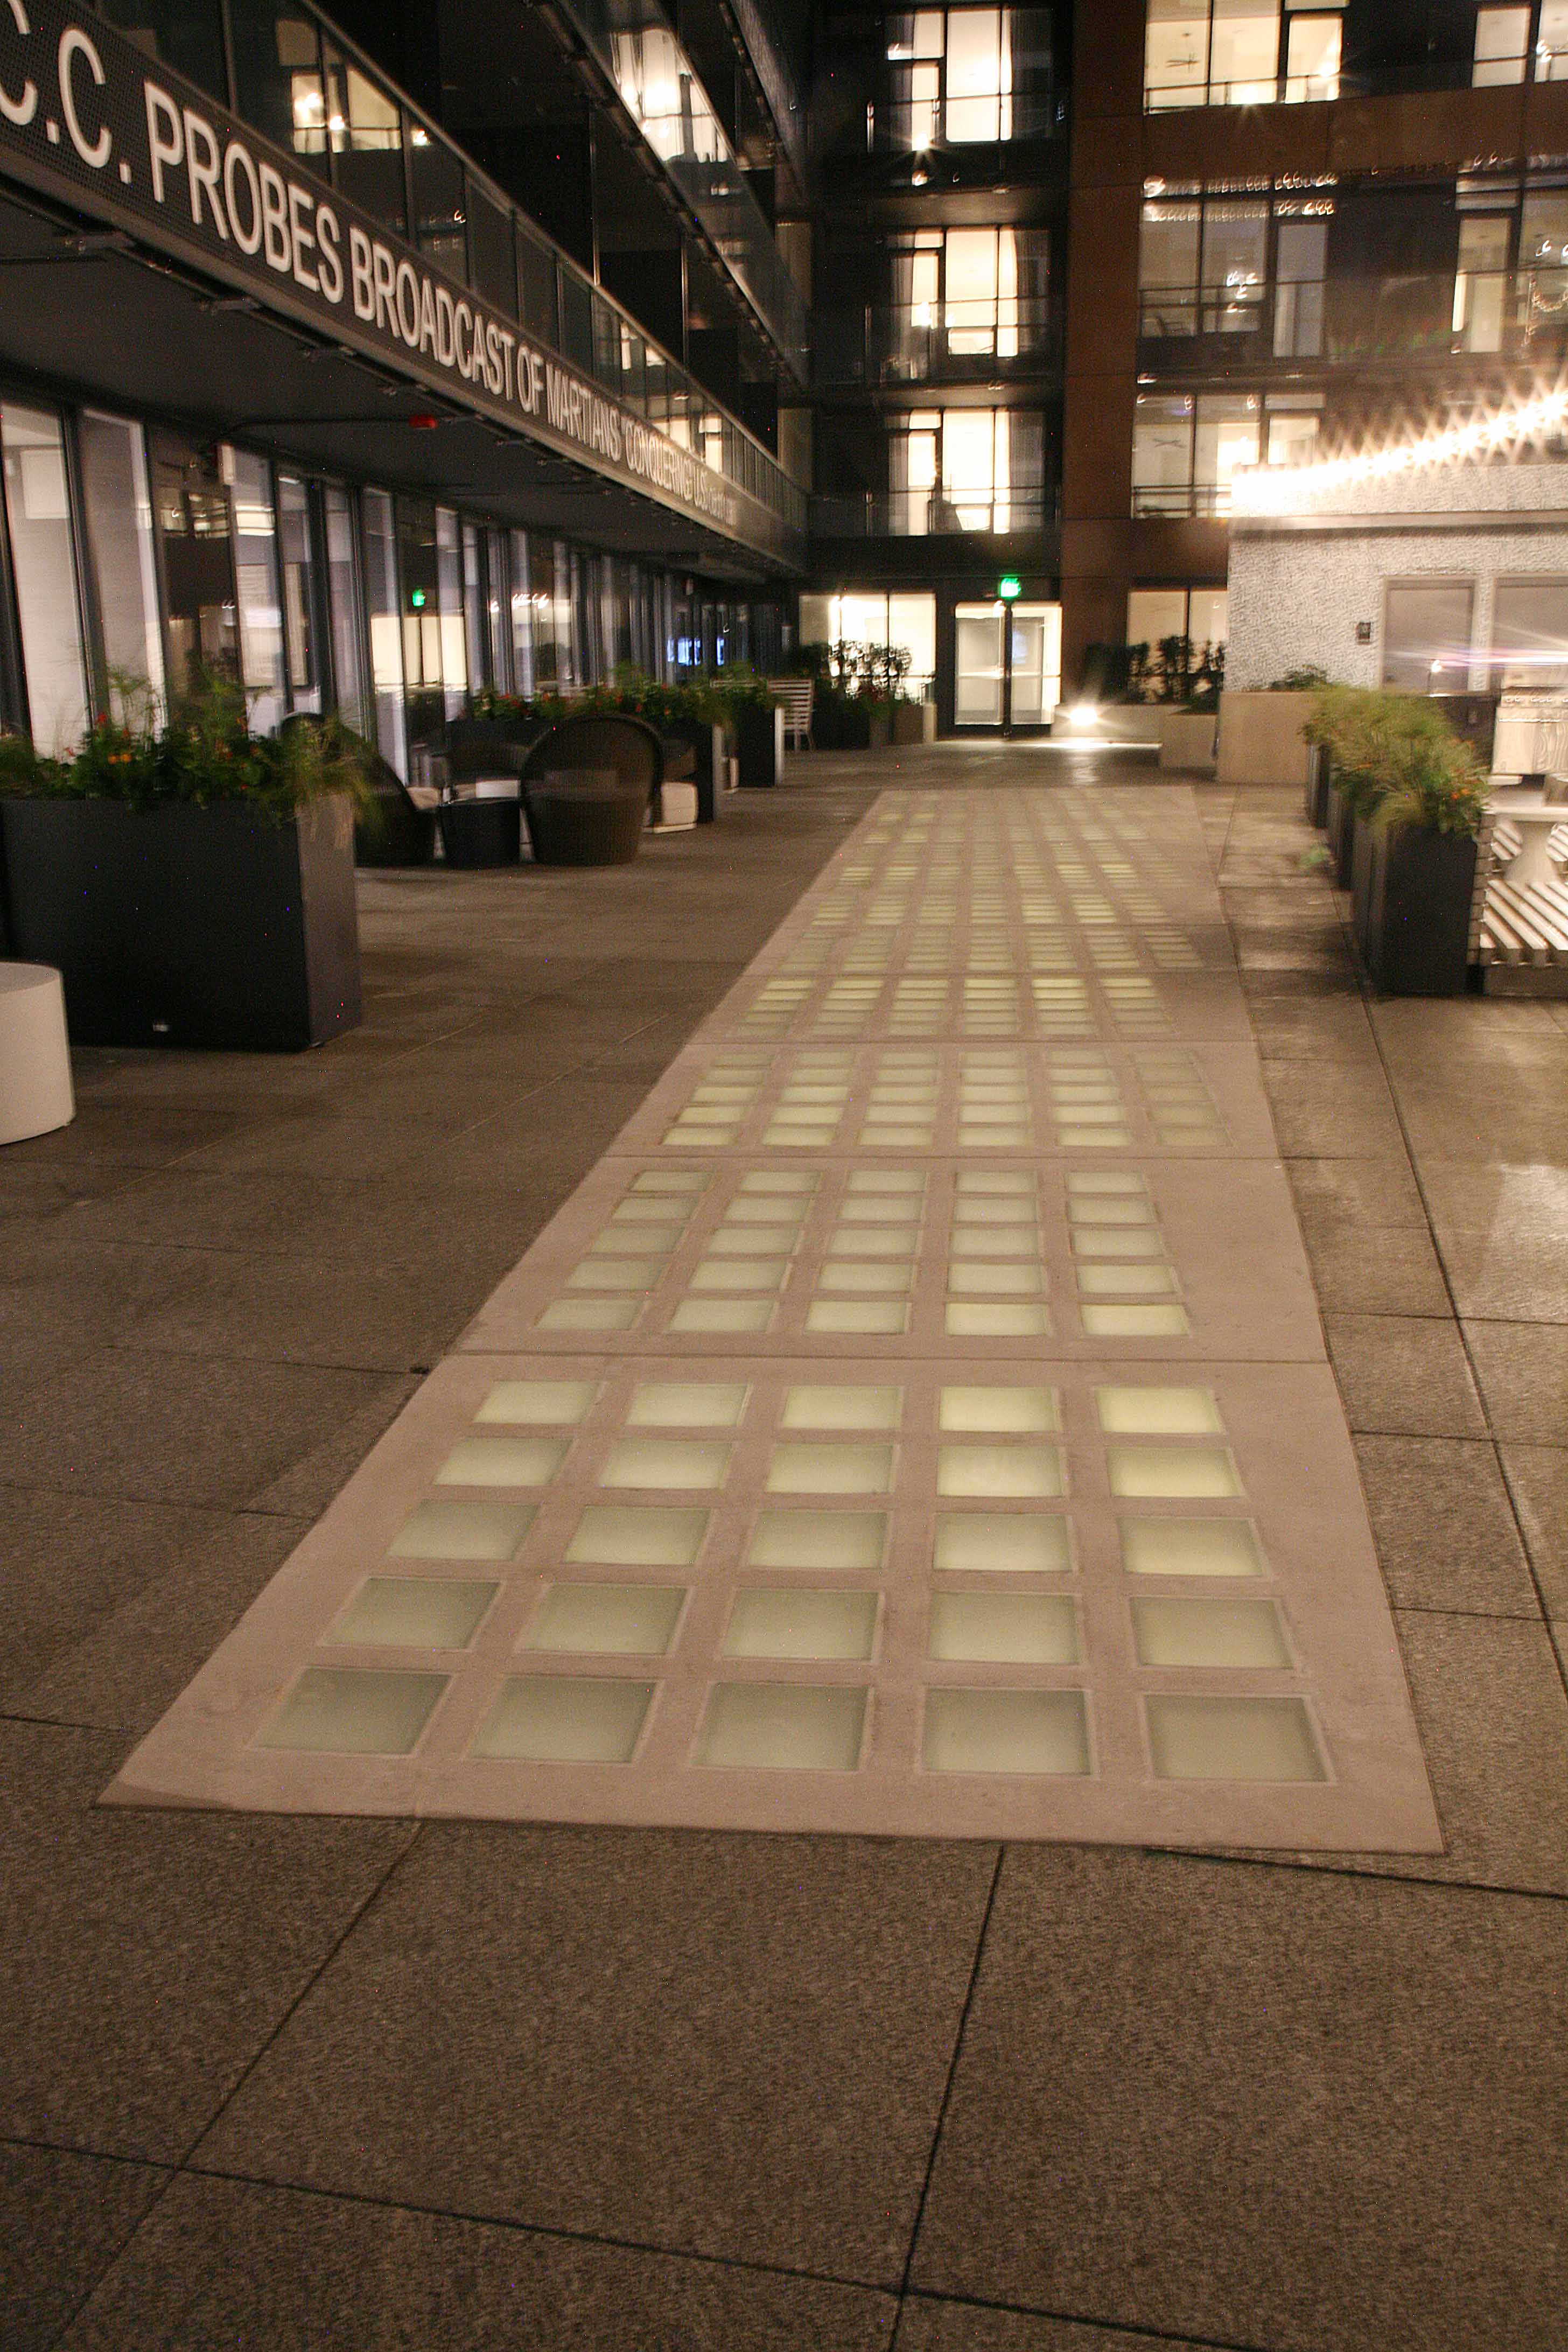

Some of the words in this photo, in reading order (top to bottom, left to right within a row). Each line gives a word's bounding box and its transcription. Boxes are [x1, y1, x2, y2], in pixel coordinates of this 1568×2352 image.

[144, 81, 344, 304] PROBES
[349, 226, 516, 401] BROADCAST
[517, 344, 544, 416] OF
[546, 362, 621, 462] MARTIANS
